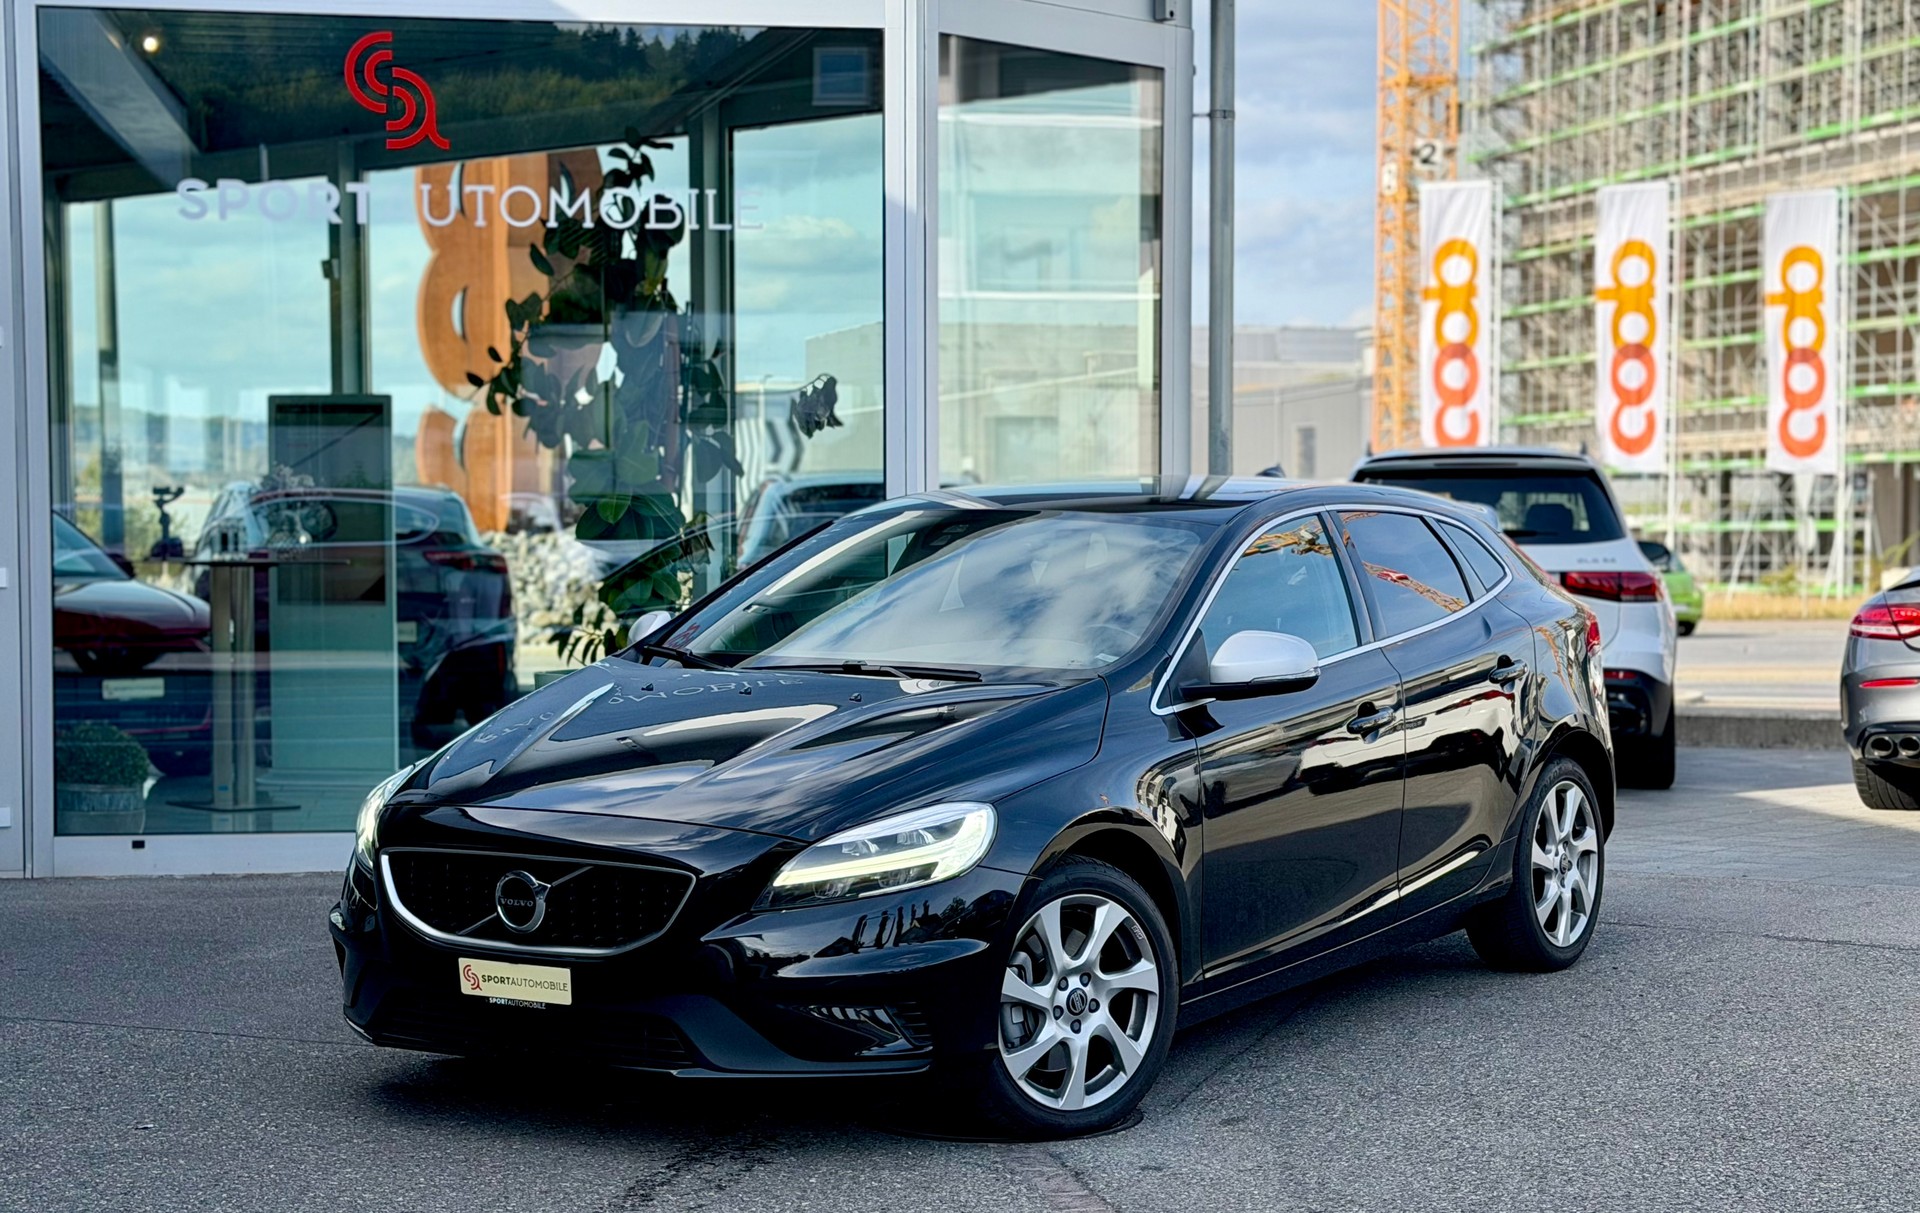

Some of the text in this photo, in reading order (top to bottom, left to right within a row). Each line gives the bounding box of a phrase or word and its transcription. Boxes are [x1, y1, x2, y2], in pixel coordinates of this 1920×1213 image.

[1419, 143, 1438, 165] 2
[382, 183, 764, 230] UTOMOBILE
[500, 897, 534, 907] VOLVO
[481, 974, 569, 992] SPORTAUTOMOBILE
[489, 997, 546, 1010] SPORTAUTOMOBILE
